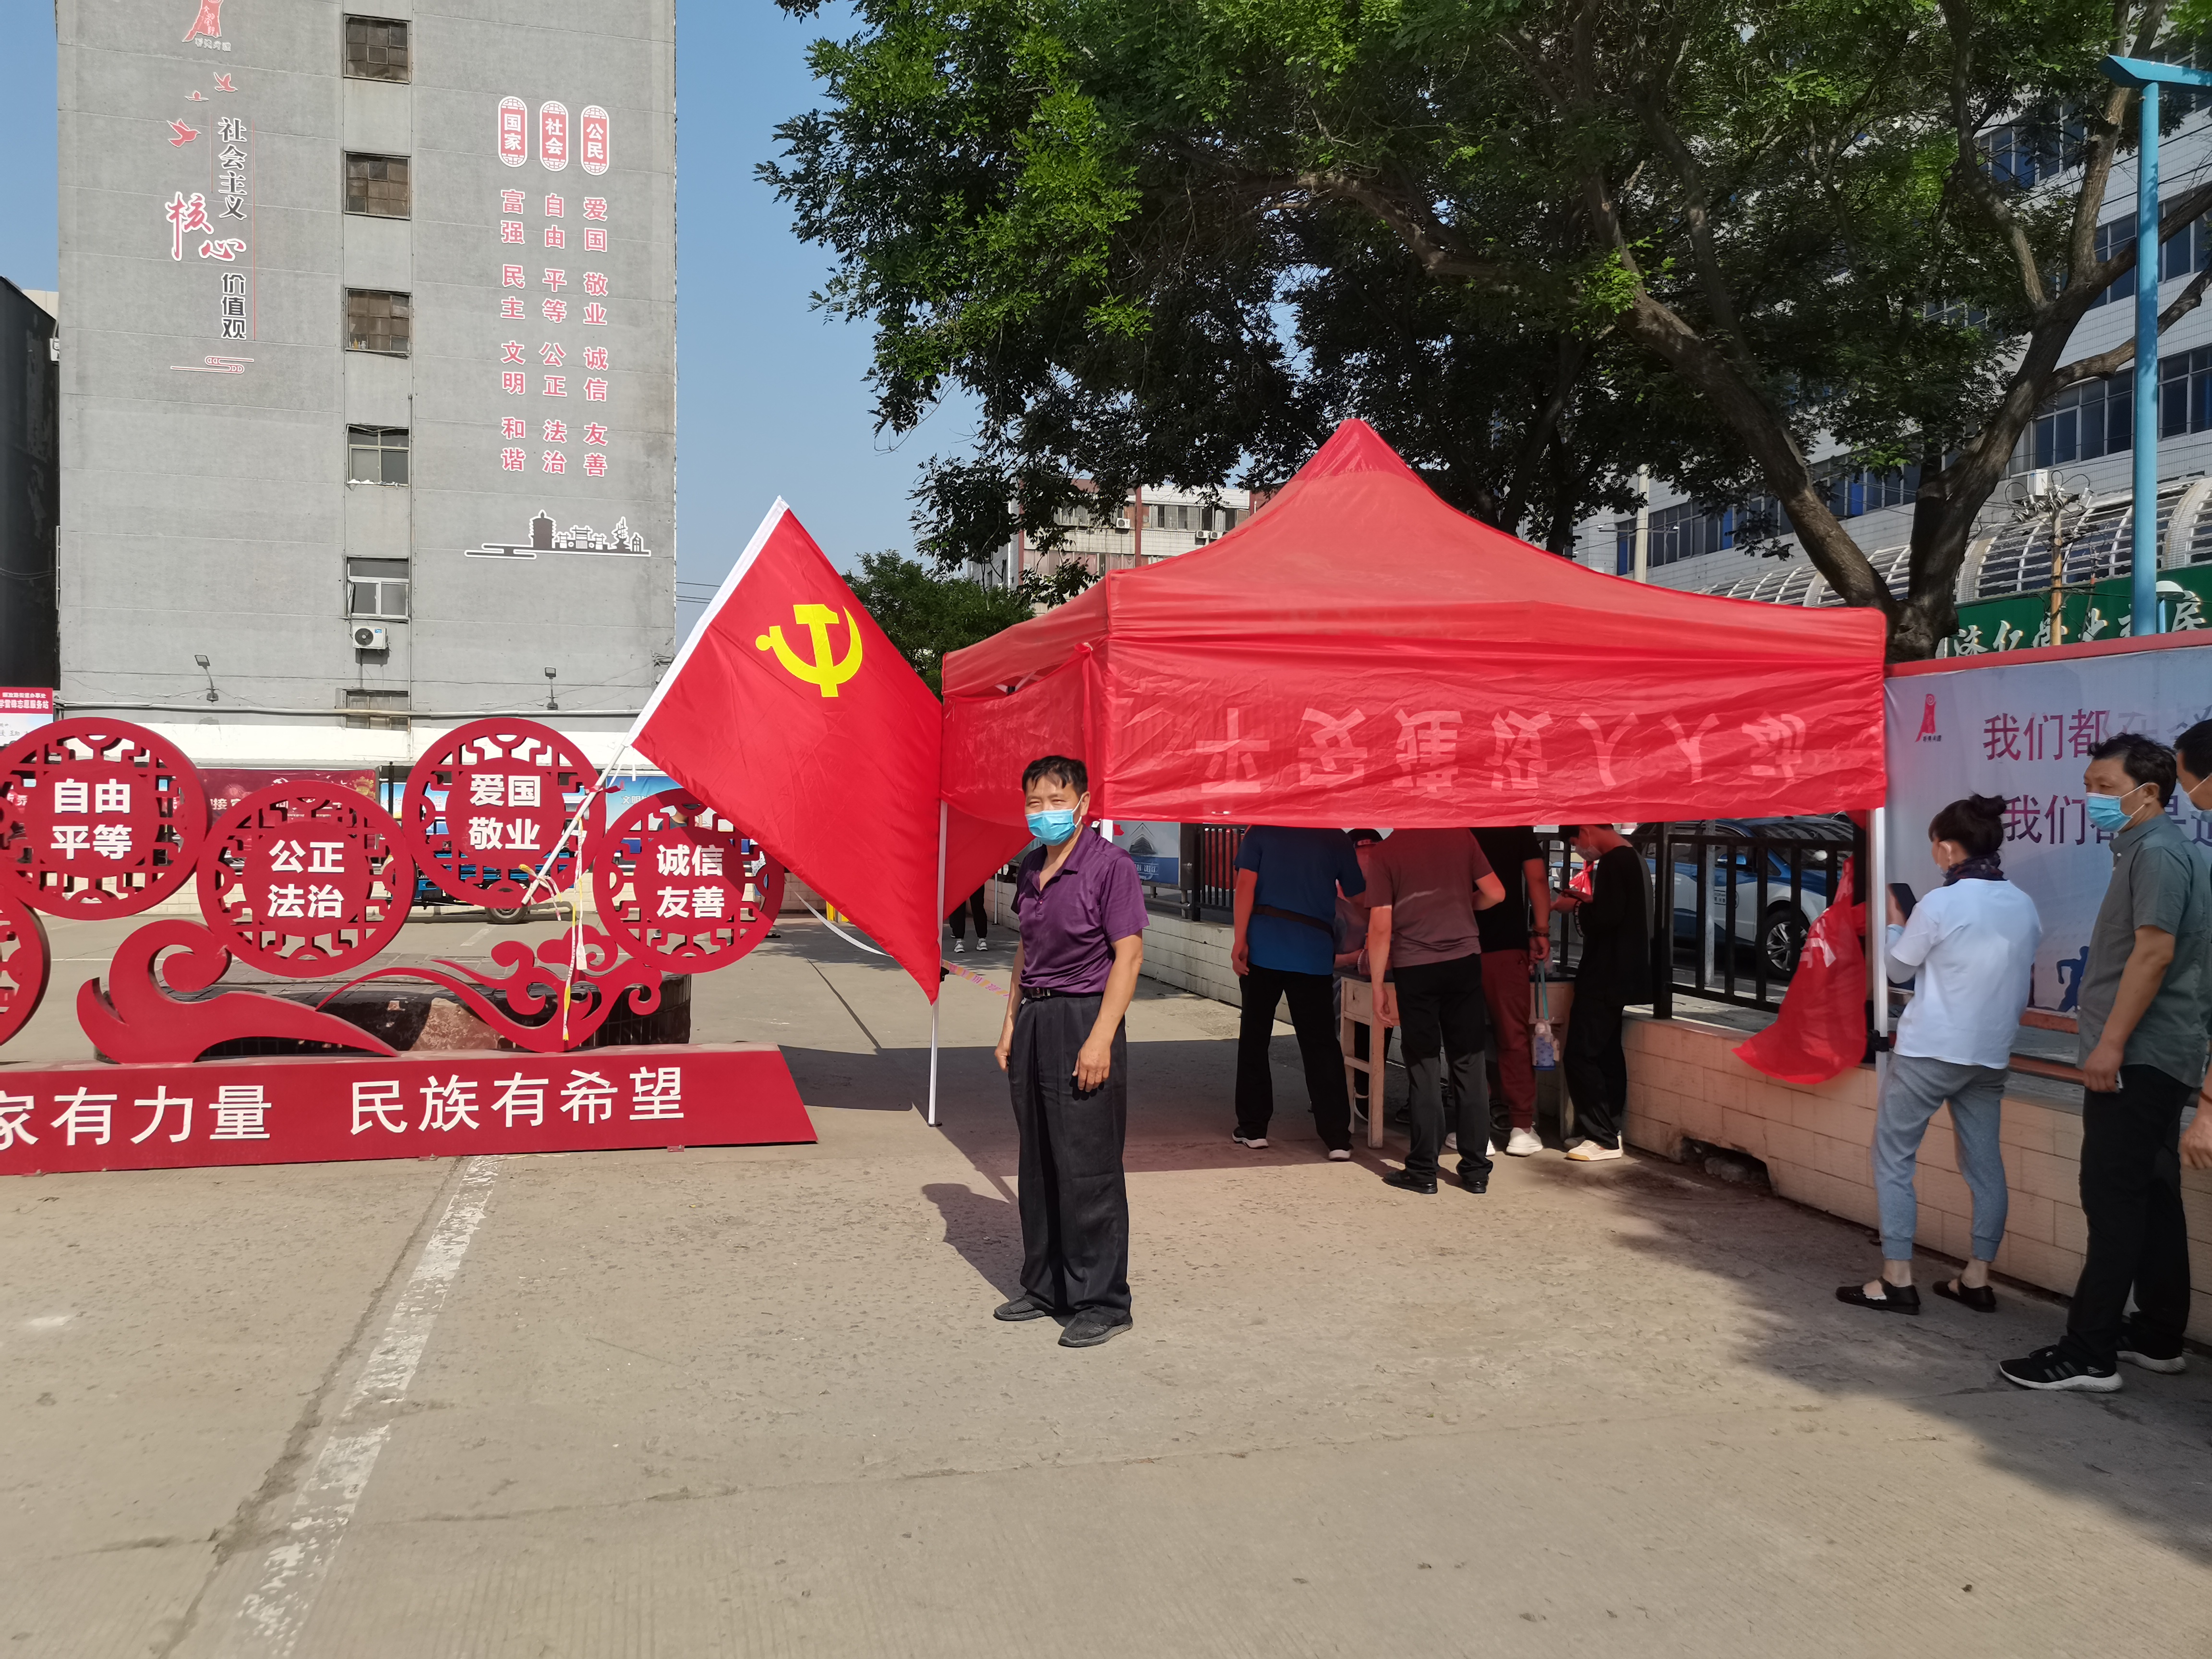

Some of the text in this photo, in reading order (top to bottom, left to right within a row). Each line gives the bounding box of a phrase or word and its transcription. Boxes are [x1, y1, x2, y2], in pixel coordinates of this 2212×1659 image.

[504, 114, 522, 151] 国家
[545, 118, 564, 156] 社会
[585, 122, 604, 160] 公民
[218, 117, 248, 220] 社会主义
[165, 191, 247, 262] 核心
[221, 272, 247, 340] 价值观
[501, 189, 526, 472] 富强 民主 文明 和谐
[540, 193, 567, 475] 自由 平等 公正 法治
[583, 197, 608, 477] 爱国 敬业 诚信 友善
[54, 778, 131, 815] 自由
[470, 774, 541, 807] 爱国
[50, 824, 132, 861] 平等
[469, 817, 541, 851] 敬业
[269, 839, 345, 874] 公正
[656, 844, 725, 877] 诚信
[267, 884, 345, 918] 法治
[656, 886, 725, 919] 友善
[0, 1066, 684, 1150] 家有力量 民族有希望
